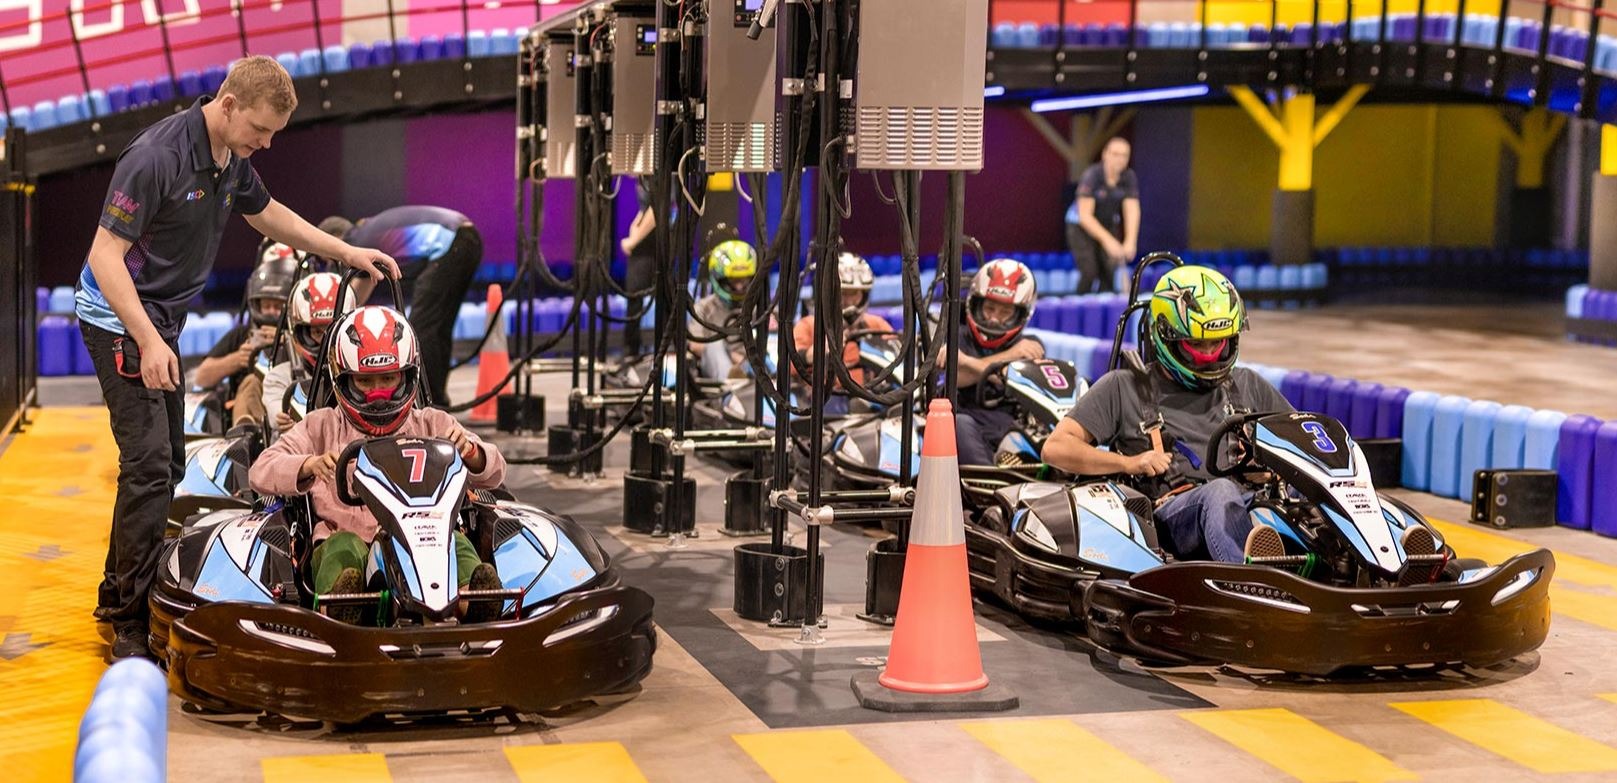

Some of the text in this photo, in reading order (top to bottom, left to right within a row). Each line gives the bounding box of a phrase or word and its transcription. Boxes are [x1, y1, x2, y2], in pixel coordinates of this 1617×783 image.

[1206, 320, 1231, 329] HJC
[364, 356, 394, 367] HJC
[1040, 365, 1069, 389] 5
[1301, 421, 1338, 453] 3
[401, 448, 427, 483] 7
